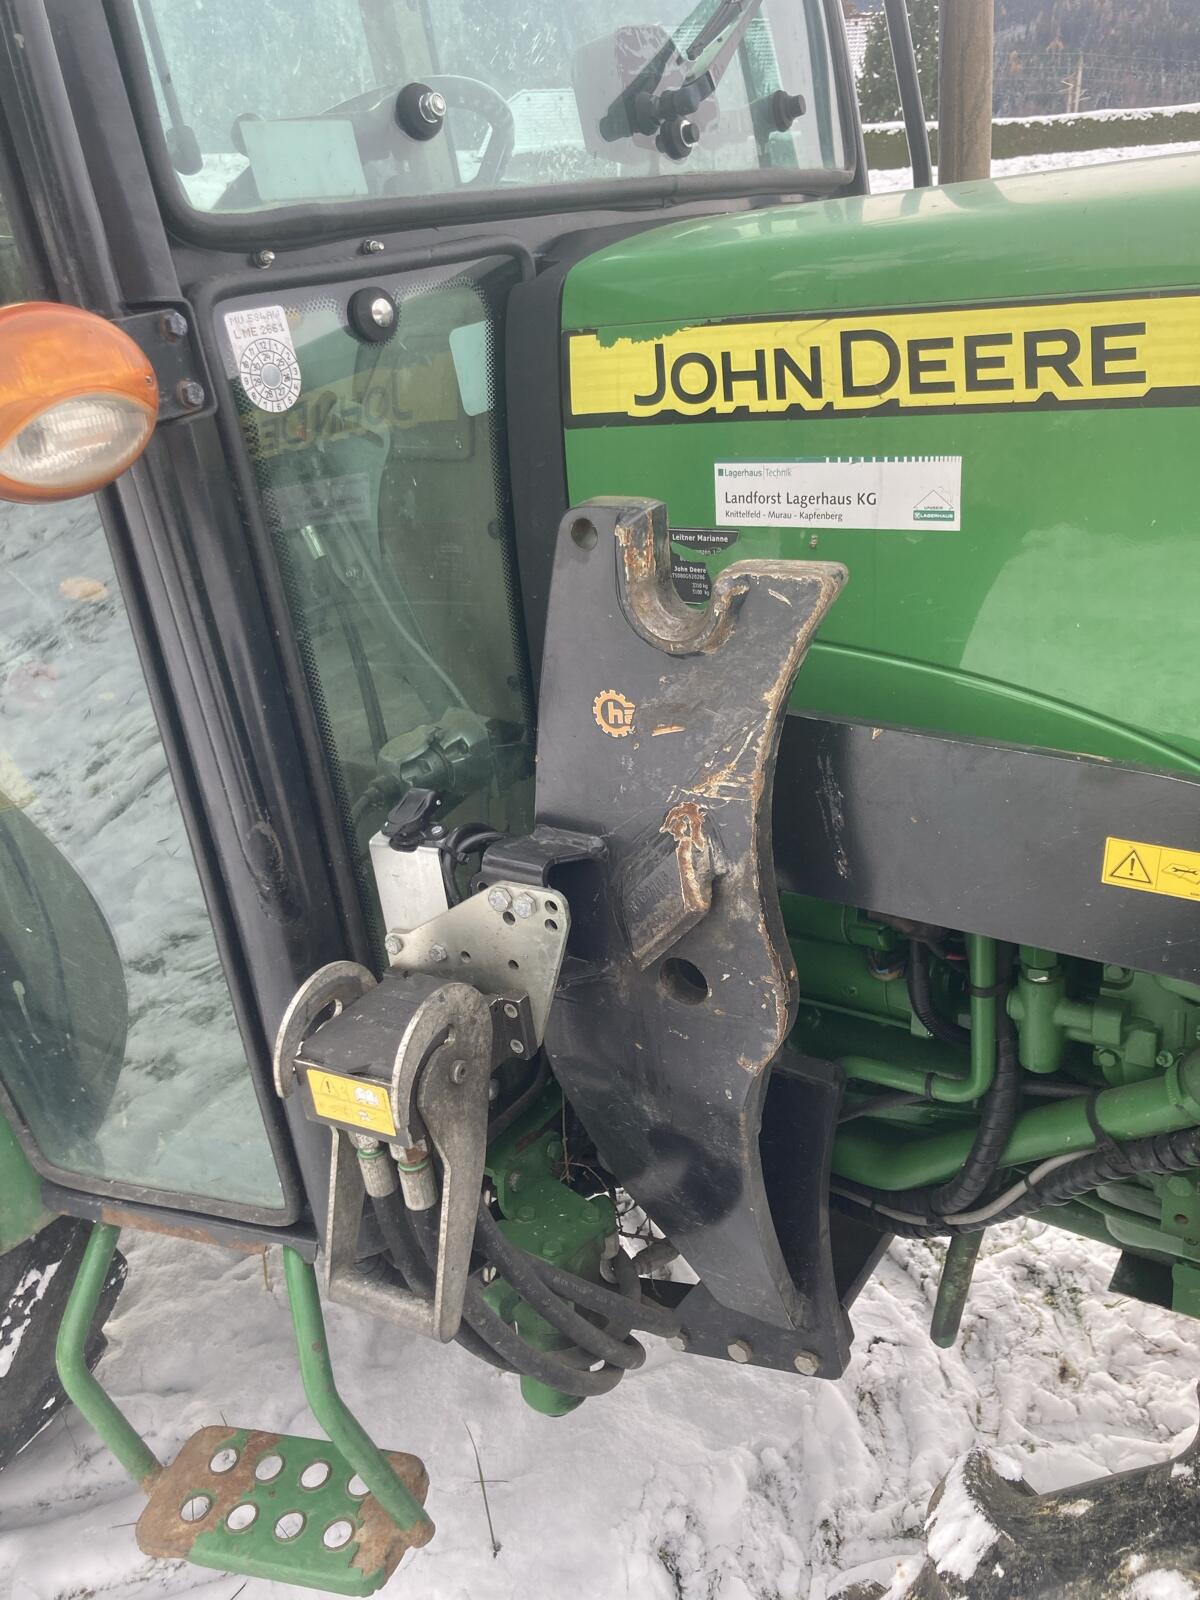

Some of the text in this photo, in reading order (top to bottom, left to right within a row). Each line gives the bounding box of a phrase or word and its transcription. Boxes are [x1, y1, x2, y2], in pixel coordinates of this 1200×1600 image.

[234, 327, 258, 340] LME
[634, 322, 1146, 406] JOHN DEERE
[724, 468, 792, 478] Lagerhaus Technik
[725, 491, 877, 508] Landforst Lagerhaus KG
[726, 510, 760, 518] Knittelfeld
[800, 512, 843, 522] Kapfenberg
[697, 534, 728, 542] Marianne
